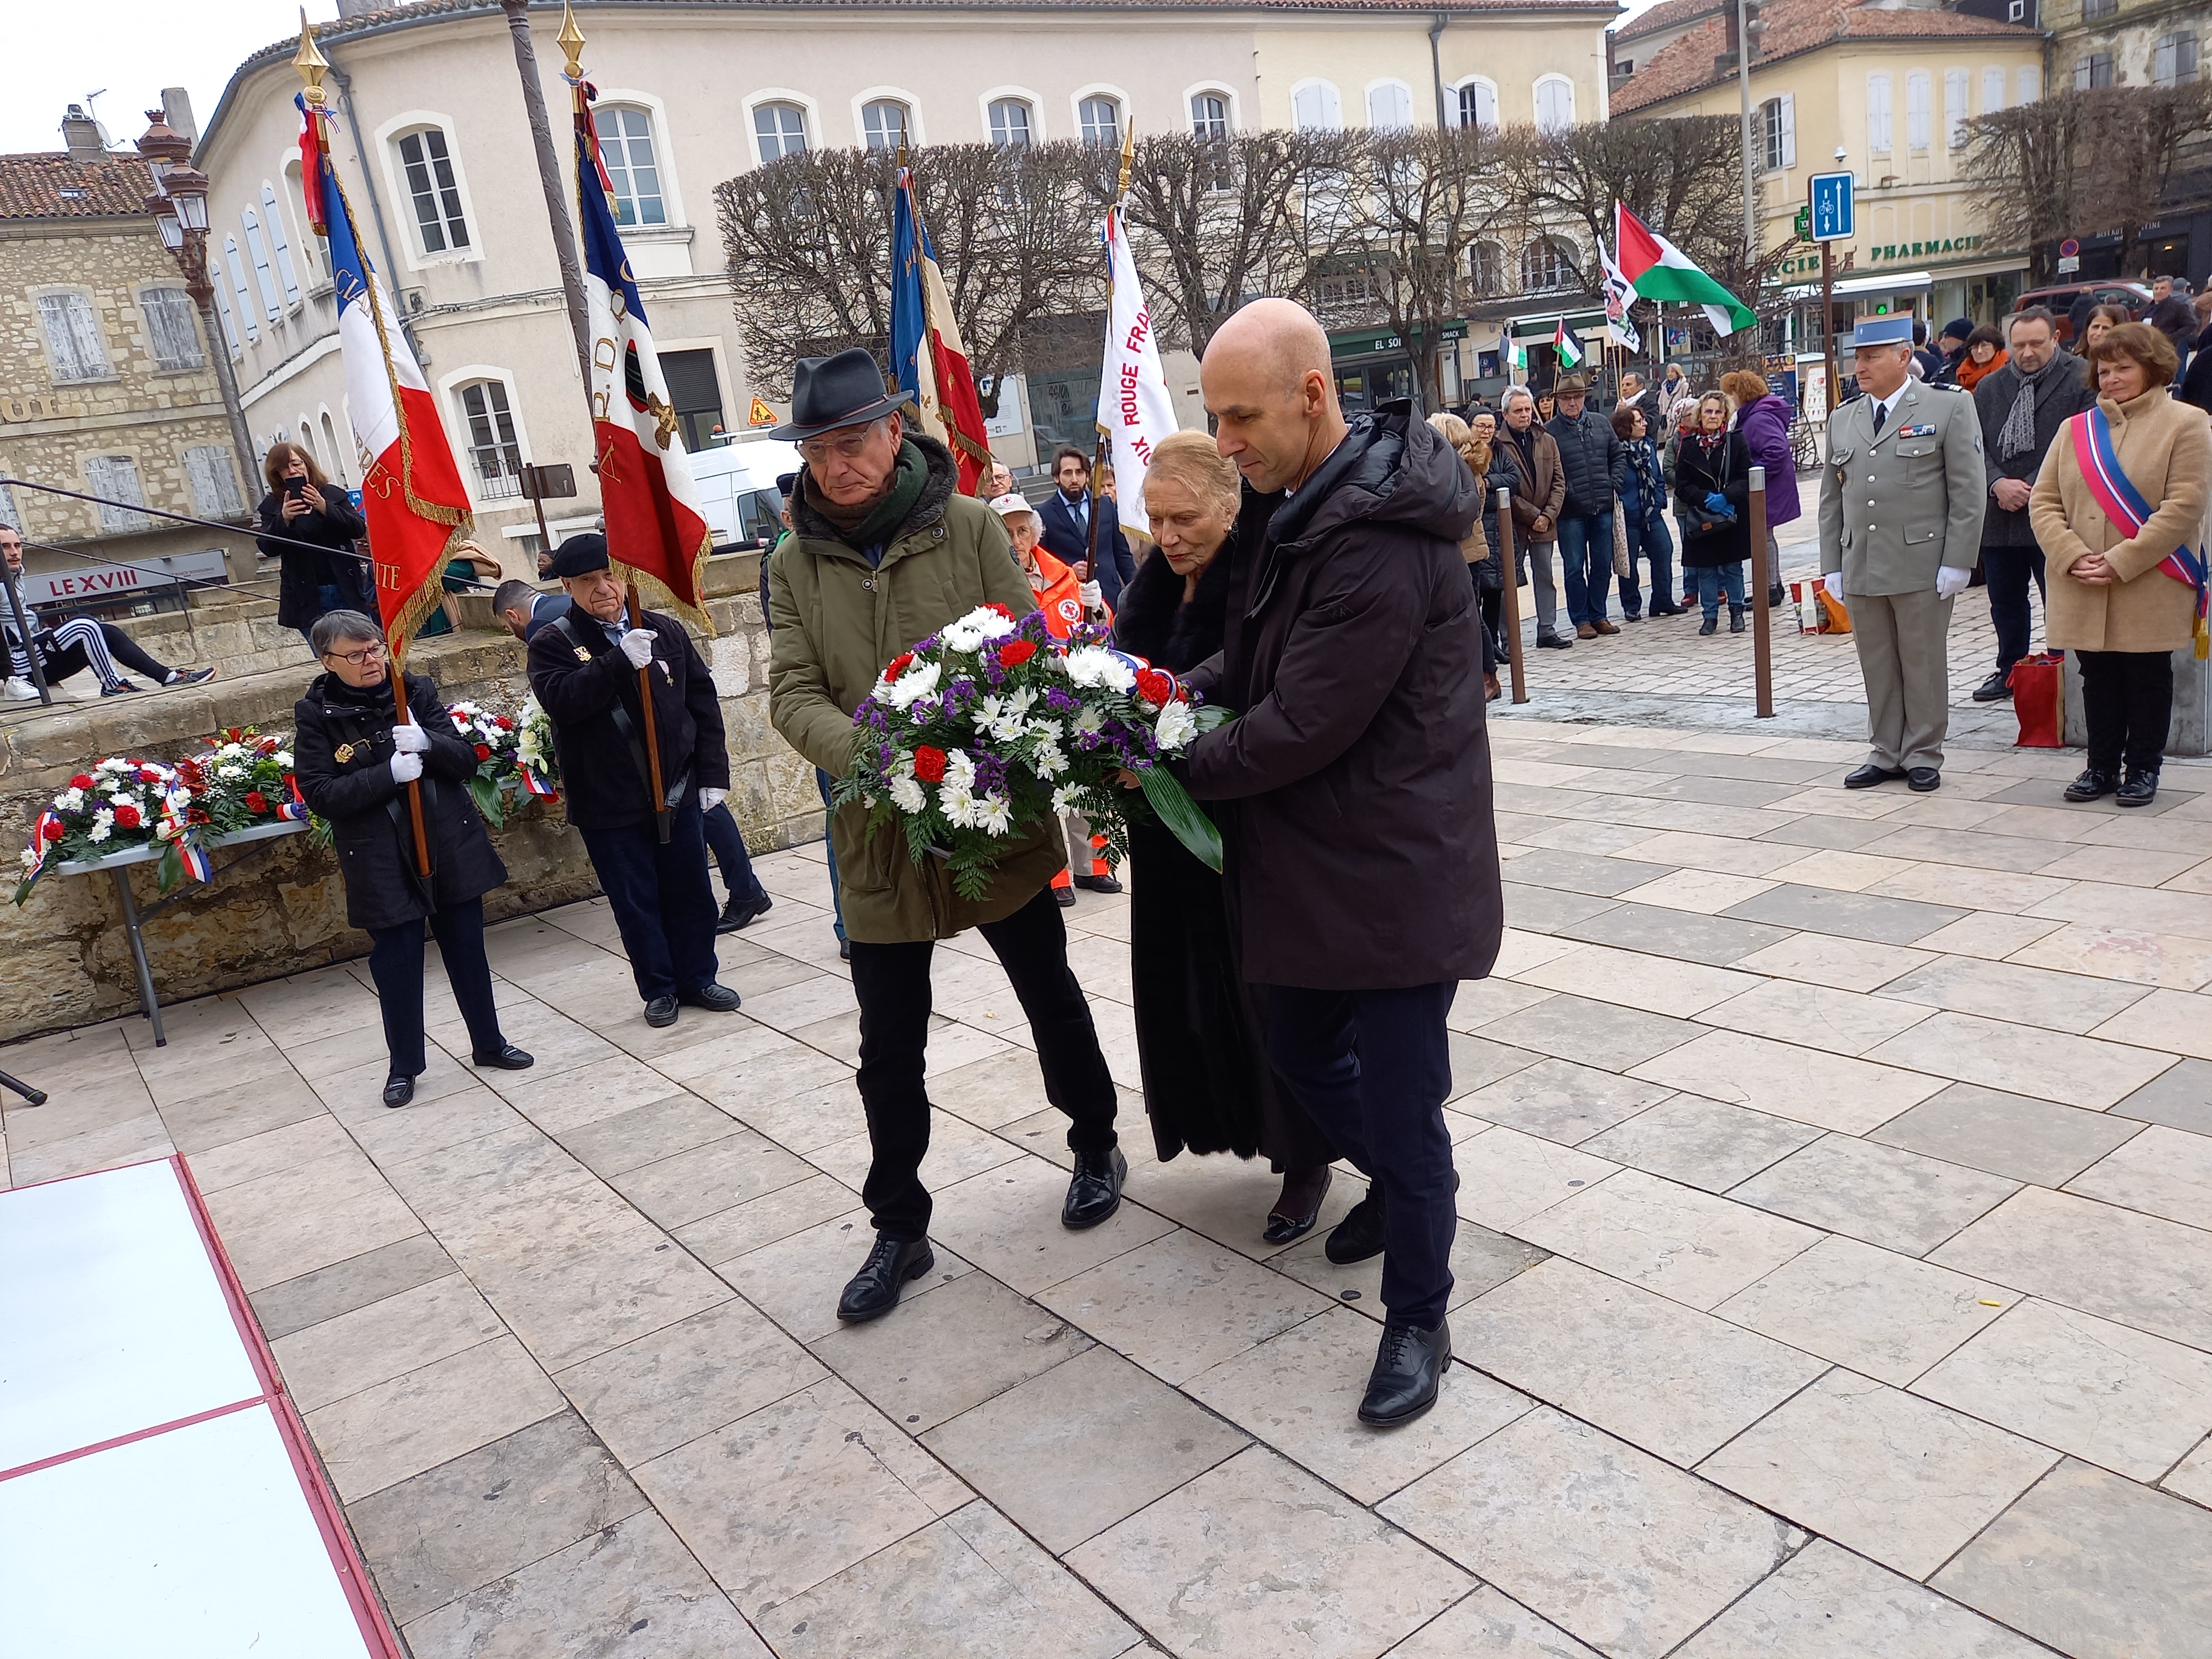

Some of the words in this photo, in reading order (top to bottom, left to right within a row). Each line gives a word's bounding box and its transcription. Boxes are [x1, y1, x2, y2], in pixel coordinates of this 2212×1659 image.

[1375, 340, 1384, 349] EL
[1442, 331, 1459, 339] SNACK
[1120, 363, 1139, 426] ROUGE
